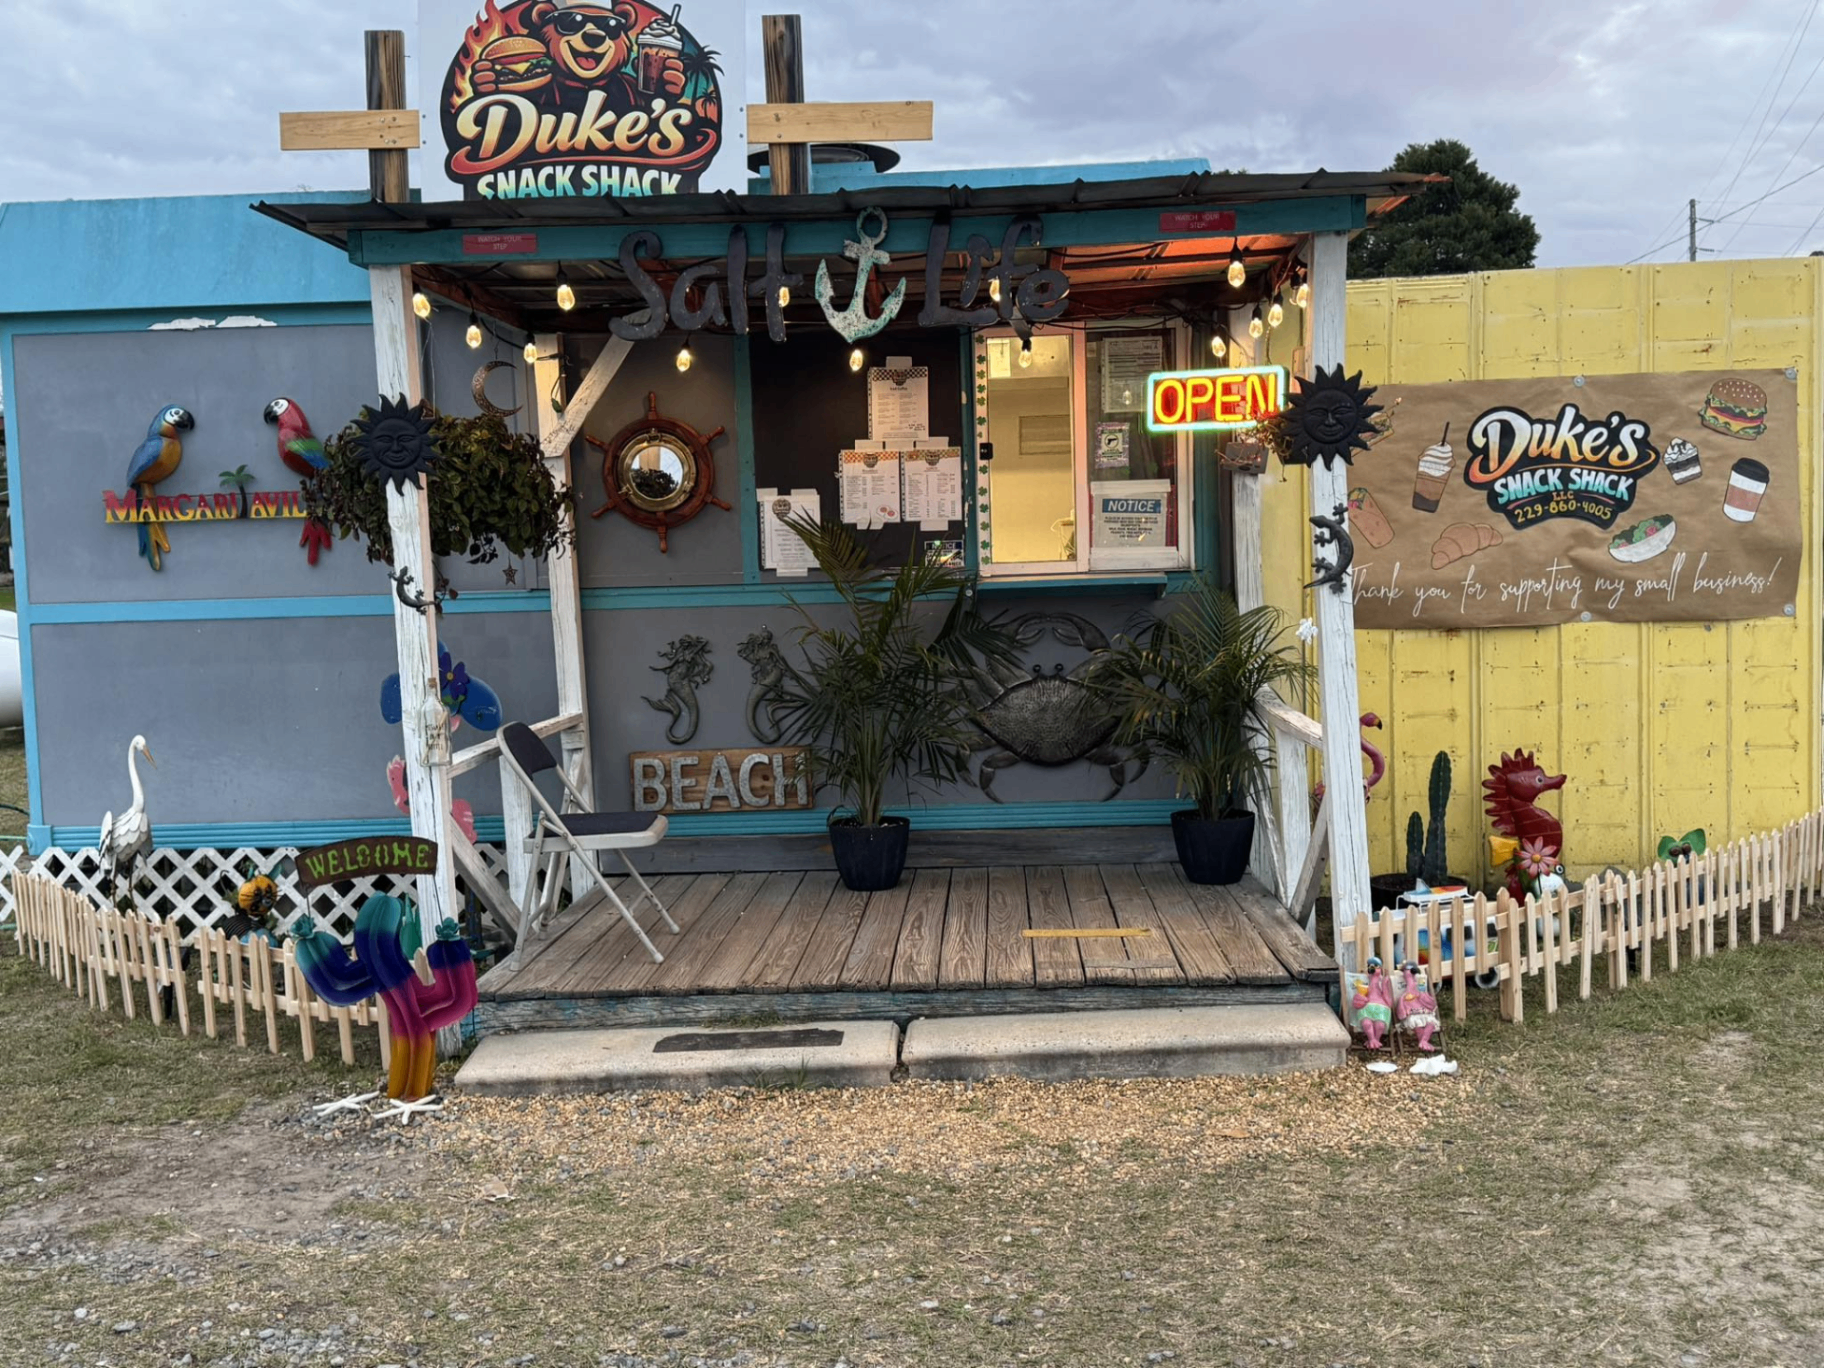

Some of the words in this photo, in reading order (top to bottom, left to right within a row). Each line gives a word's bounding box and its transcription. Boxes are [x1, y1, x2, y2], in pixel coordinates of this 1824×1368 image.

[452, 89, 693, 170] Duke's
[477, 165, 575, 200] SNACK
[581, 165, 682, 197] SHACK
[608, 222, 804, 342] Salt
[1155, 373, 1276, 424] OPEN
[1469, 405, 1646, 483] Duke's
[1107, 500, 1156, 512] NOTICE
[1493, 468, 1563, 505] SNACK
[1568, 467, 1634, 501] SHACK
[1552, 491, 1575, 501] LLC
[1352, 562, 1404, 606] Thank
[1412, 586, 1450, 617] you
[1460, 564, 1487, 613] for
[1500, 557, 1583, 612] supporting
[1595, 577, 1625, 609] my
[1634, 552, 1686, 601] small
[1693, 552, 1782, 595] business!
[634, 752, 808, 812] BEACH
[305, 842, 430, 879] WELCOME
